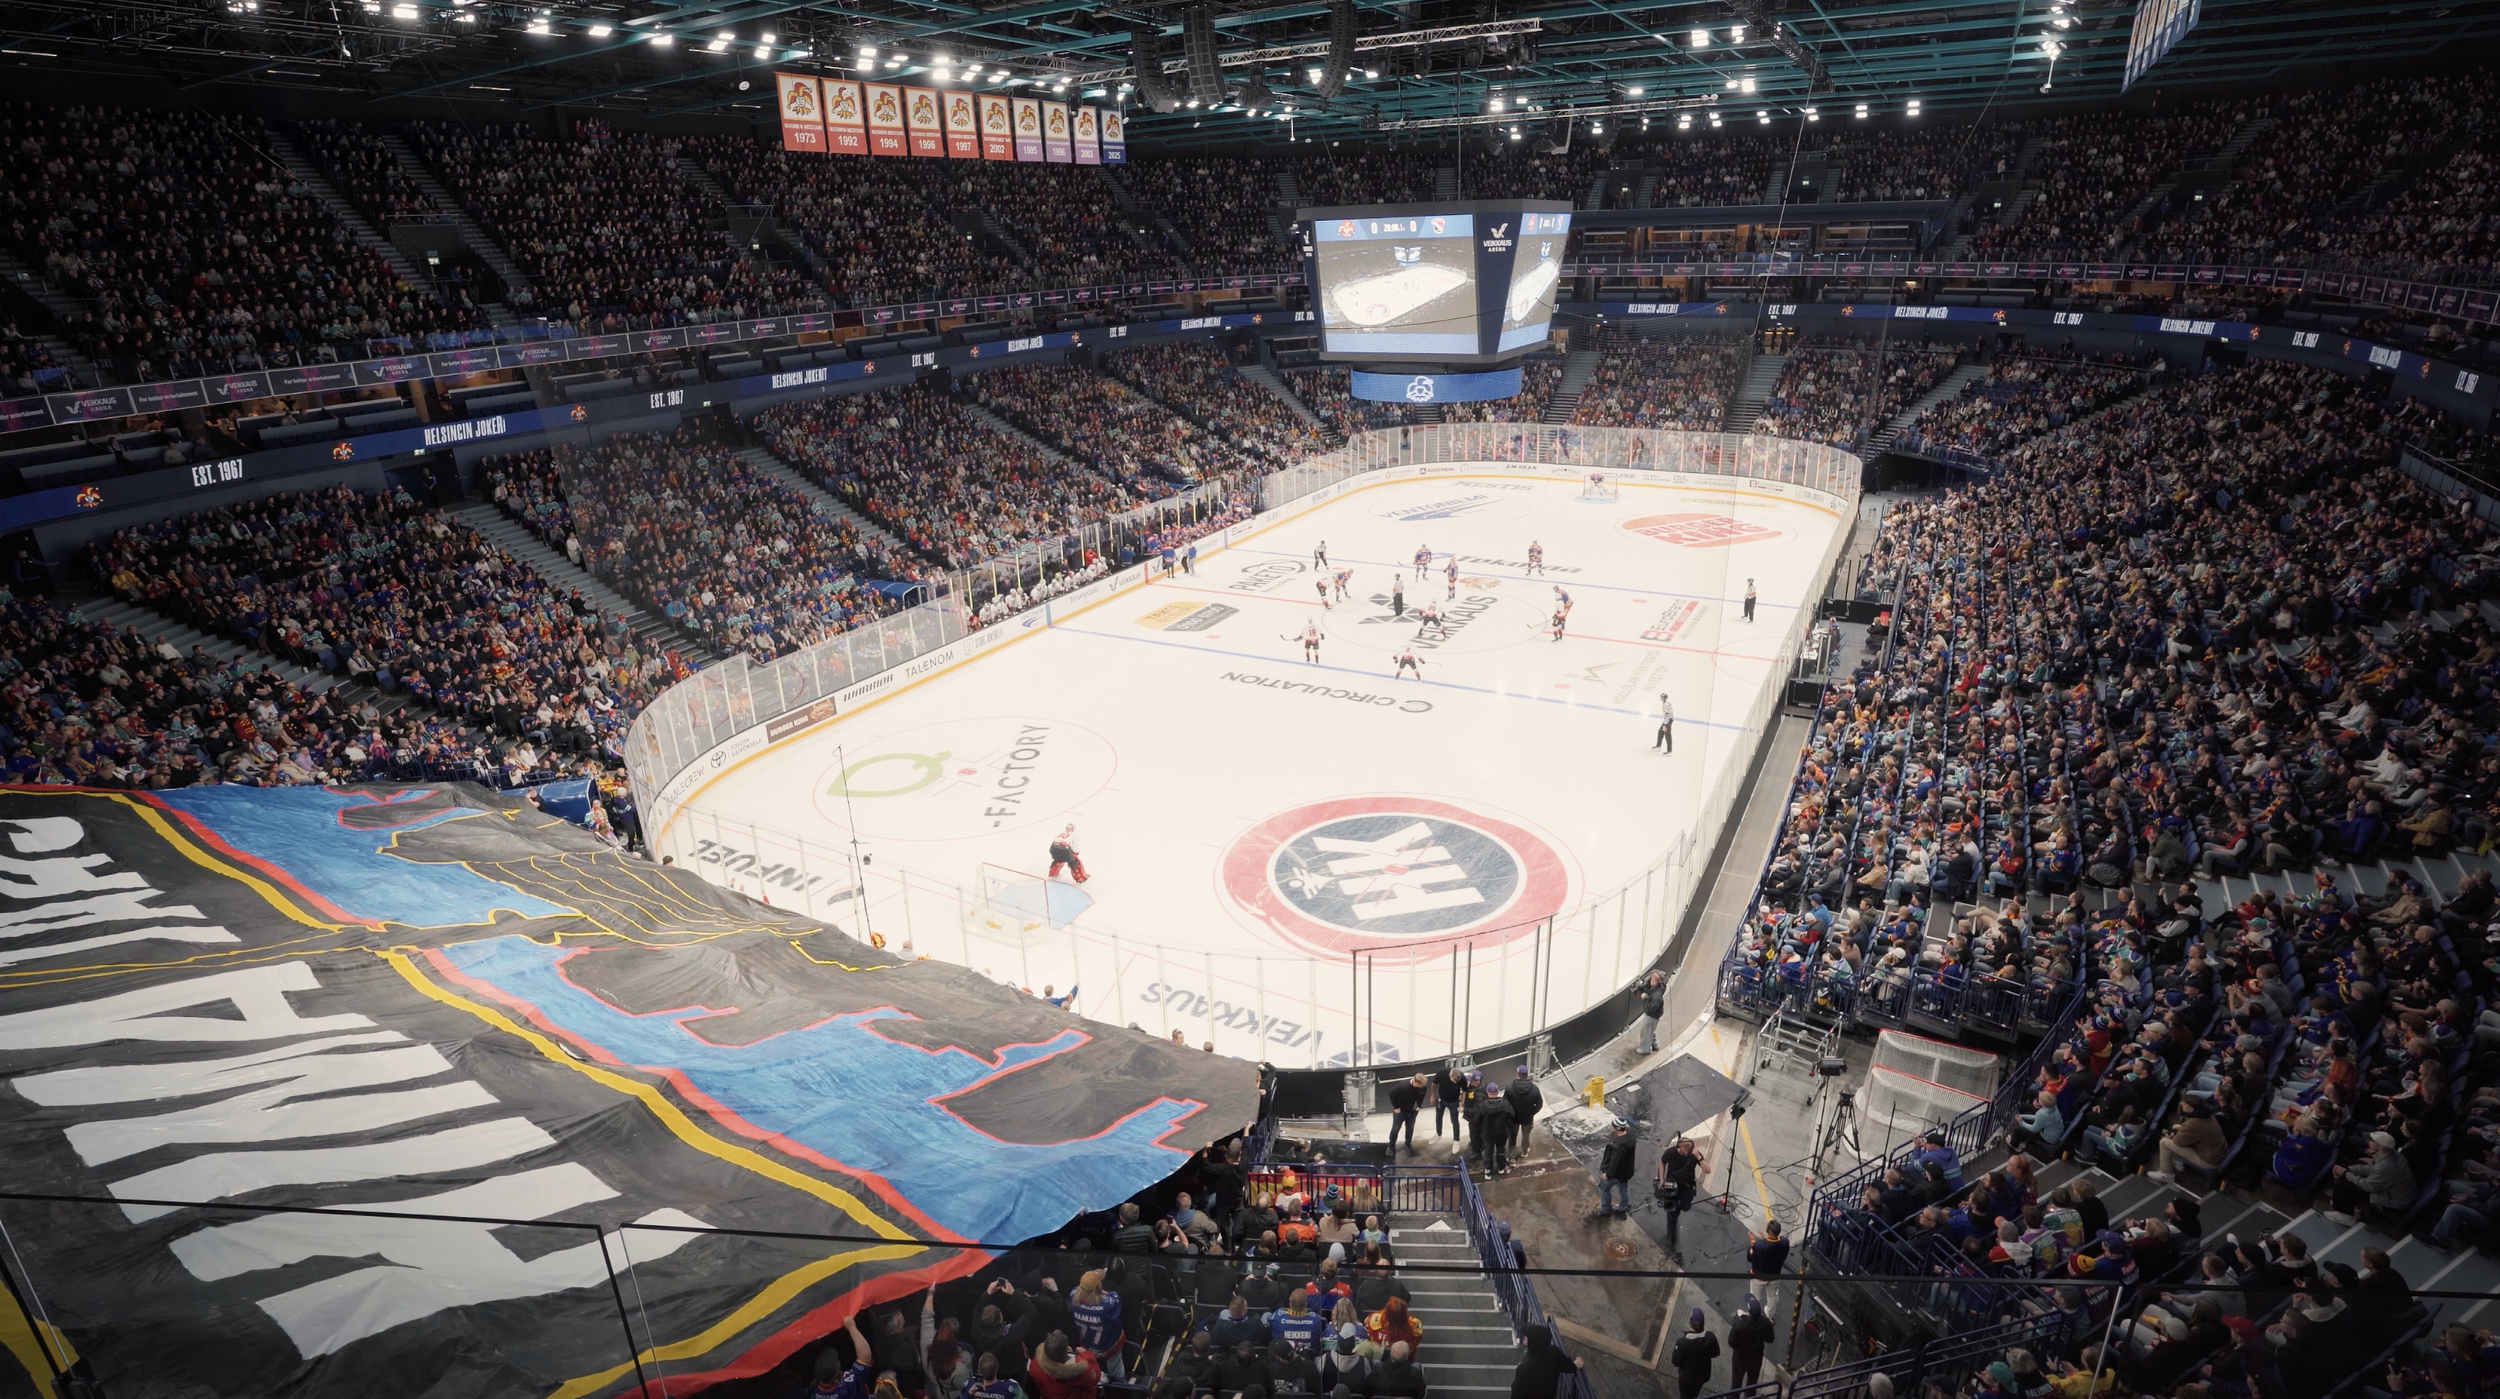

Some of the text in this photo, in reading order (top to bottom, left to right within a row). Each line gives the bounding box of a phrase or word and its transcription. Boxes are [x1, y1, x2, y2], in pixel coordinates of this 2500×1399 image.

[794, 132, 816, 144] 1973
[838, 135, 858, 147] 1992
[879, 137, 898, 149] 1994
[918, 139, 936, 150] 1996
[955, 142, 972, 151] 1997
[989, 144, 1005, 154] 2002
[1023, 145, 1038, 155] 1995
[1052, 147, 1066, 157] 1996
[1080, 149, 1094, 159] 2003
[1108, 151, 1121, 160] 2025
[1371, 222, 1378, 234] 0
[1410, 220, 1417, 232] 0
[1483, 239, 1512, 247] VEIKKAUS
[1768, 305, 1797, 315] EST. 1967
[2053, 312, 2084, 325] EST. 1967
[308, 374, 341, 382] entertainment
[771, 371, 803, 389] HELSINGIN
[228, 380, 258, 389] VEIKKAUS
[80, 396, 117, 407] VEIKKAUS
[164, 391, 199, 400] entertainment
[650, 389, 684, 409] EST. 1967
[10, 409, 44, 419] entertainment
[424, 421, 473, 446] HELSINGIN
[192, 458, 244, 487] EST. 1967
[1378, 494, 1489, 518] VENTONIEMI
[1633, 516, 1741, 536] BURGER
[1653, 523, 1769, 545] KING
[1228, 565, 1296, 591] PAKETO
[1308, 628, 1317, 637] 18
[904, 650, 955, 678] TALENOM
[843, 674, 894, 702] WARRIOR
[1220, 671, 1397, 706] CIRCULATION
[770, 715, 809, 737] BURGER KING
[730, 737, 750, 751] TOYOTA
[1140, 982, 1324, 1053] VEIKKAUS
[1075, 1321, 1104, 1345] 77
